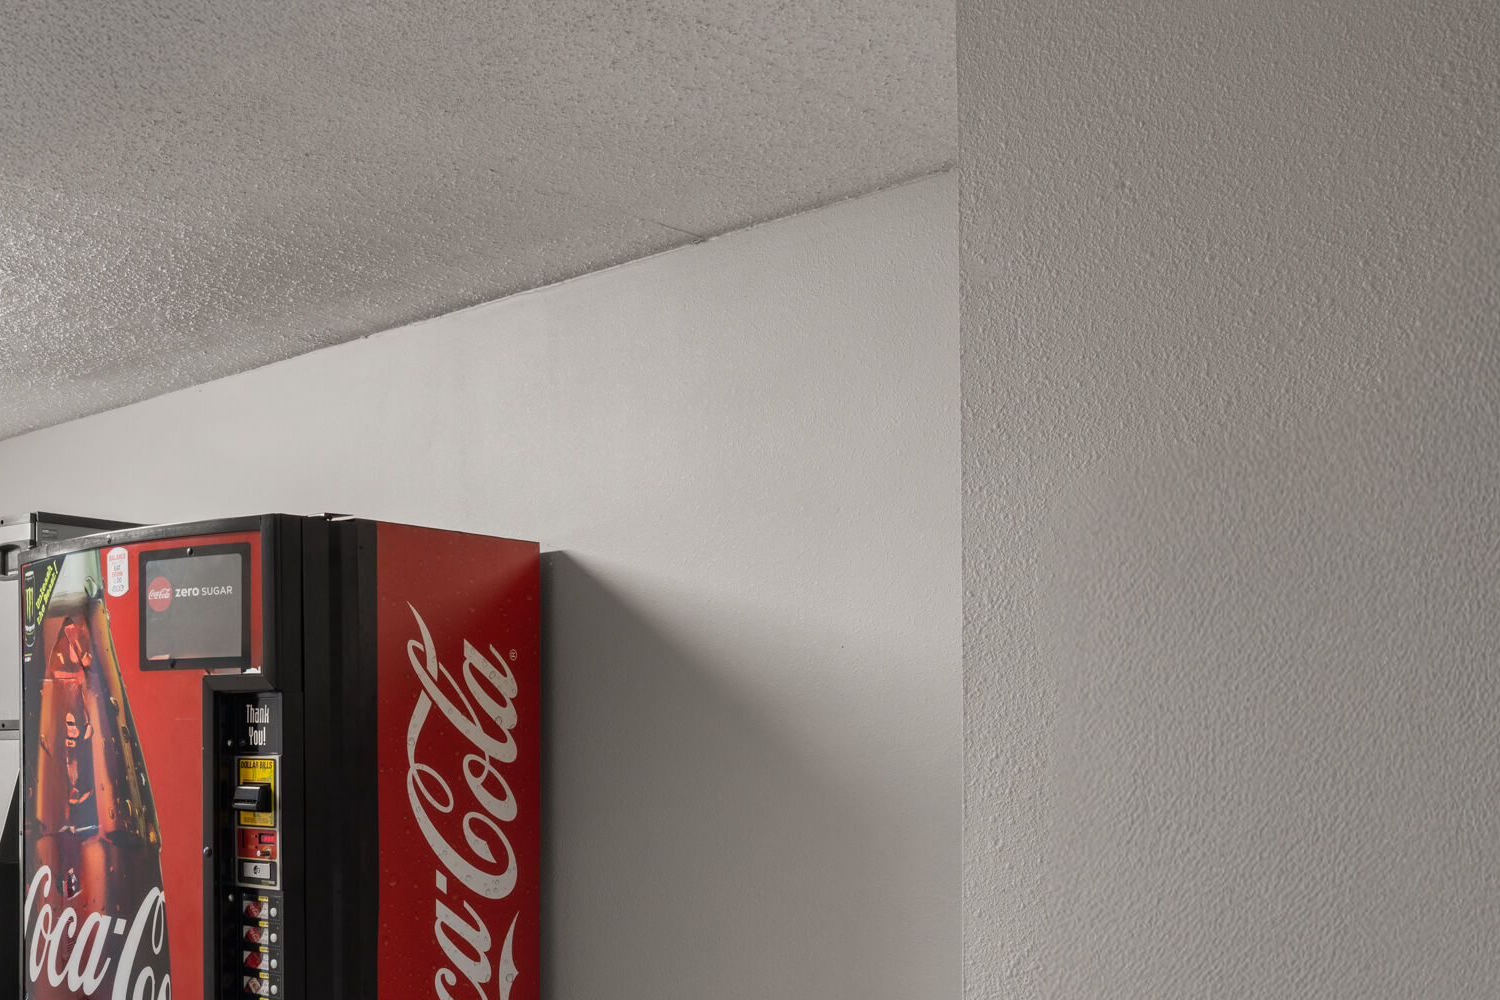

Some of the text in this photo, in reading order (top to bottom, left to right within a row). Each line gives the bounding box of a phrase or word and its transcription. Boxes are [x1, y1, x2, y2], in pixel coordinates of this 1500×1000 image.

[174, 586, 200, 598] zero
[201, 585, 233, 596] SUGAR
[246, 704, 270, 724] Thank
[248, 726, 267, 746] You!
[240, 761, 273, 770] DOLLAR BILLS
